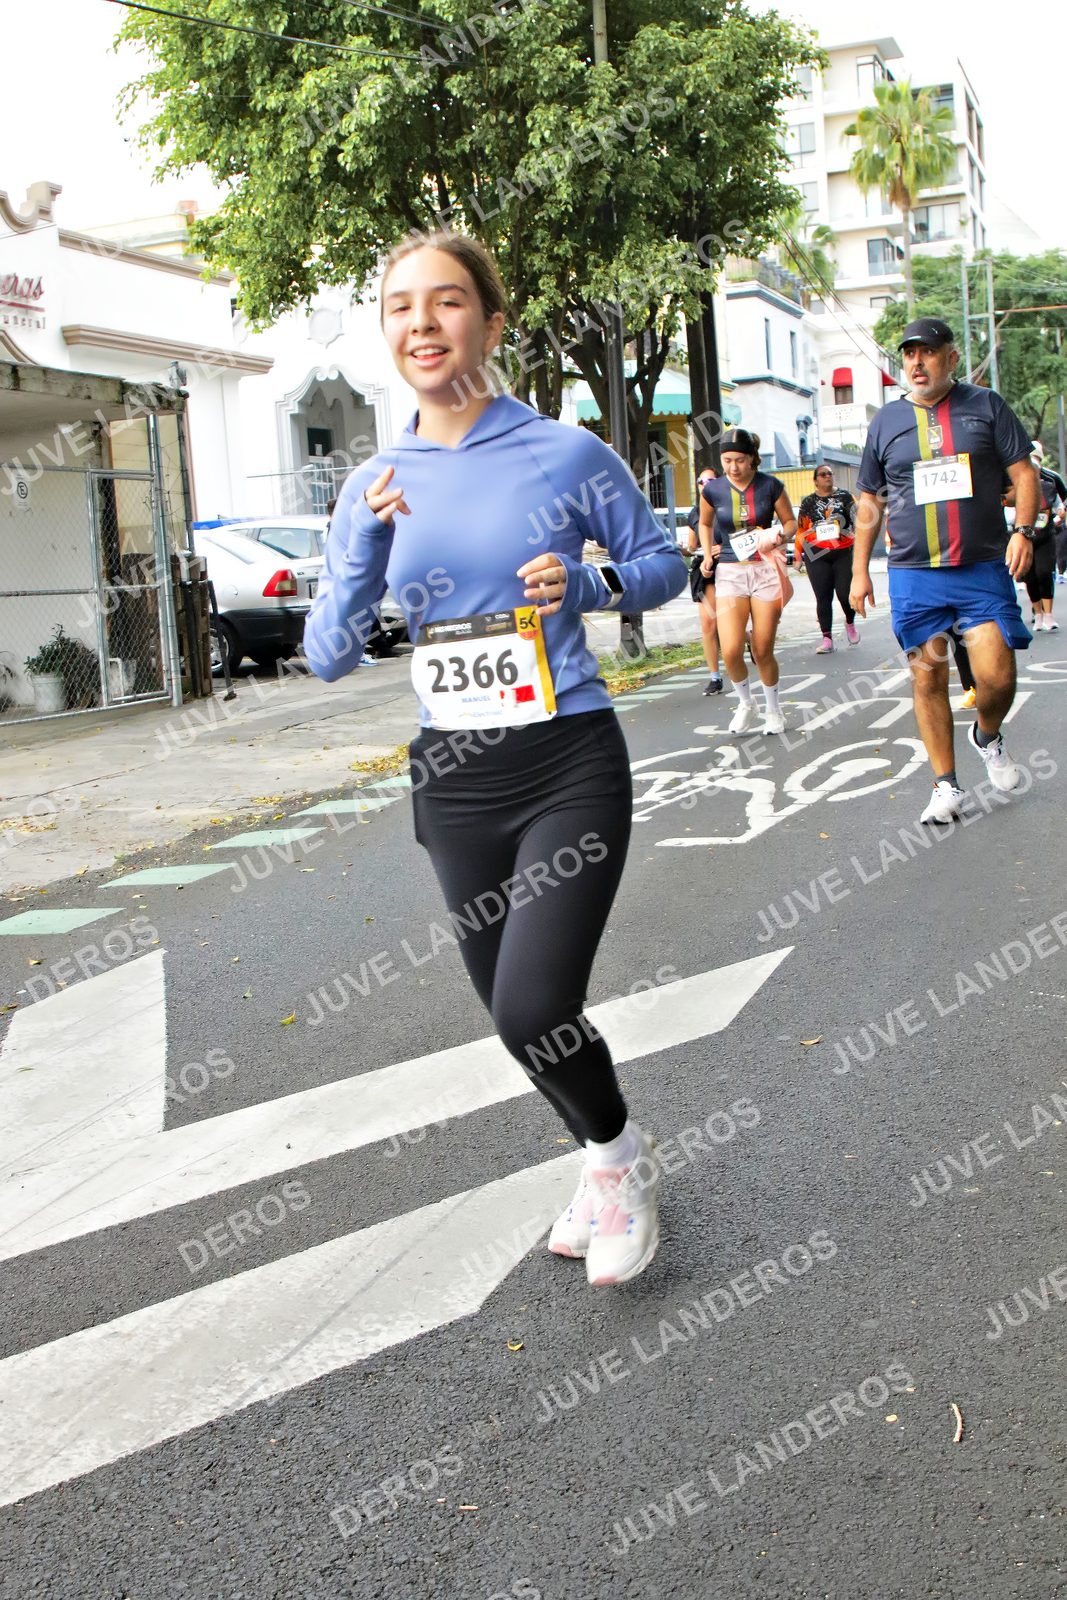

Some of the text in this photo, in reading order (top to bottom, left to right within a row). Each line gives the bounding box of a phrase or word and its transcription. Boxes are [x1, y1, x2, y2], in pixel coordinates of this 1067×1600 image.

[922, 469, 958, 488] 1742
[427, 648, 519, 693] 2366
[461, 695, 491, 703] MANUEL
